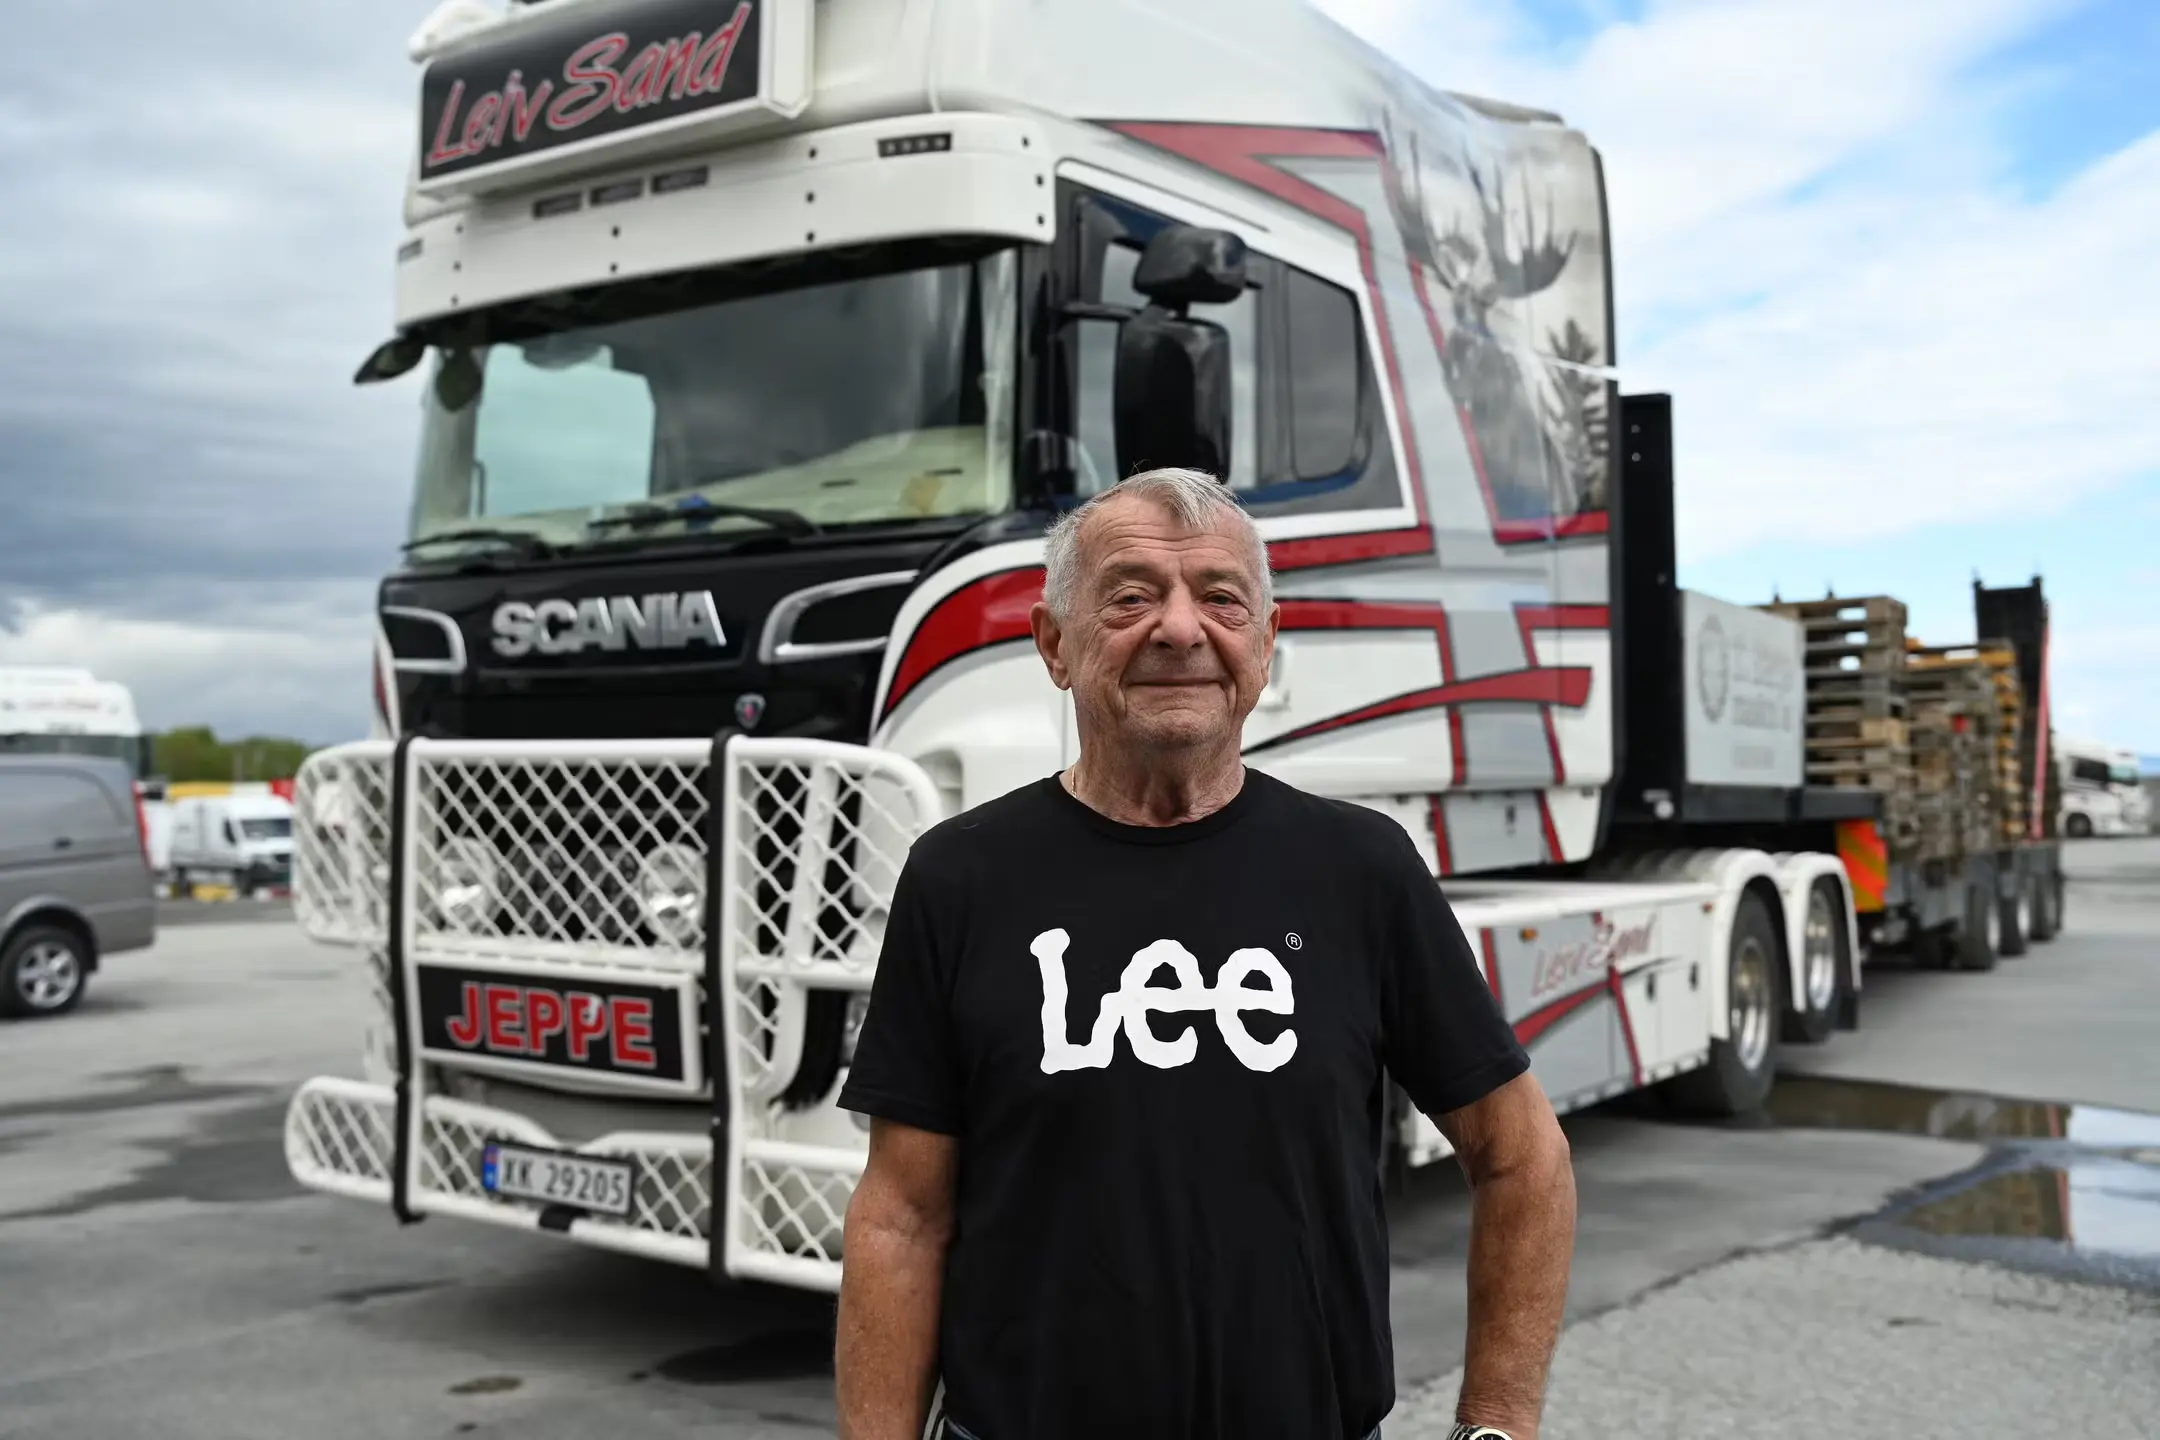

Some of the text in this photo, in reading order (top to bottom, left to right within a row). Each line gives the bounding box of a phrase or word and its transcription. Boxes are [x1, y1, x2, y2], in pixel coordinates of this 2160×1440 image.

[425, 2, 752, 167] Leiv Sand
[491, 590, 727, 657] SCANIA
[446, 981, 657, 1068] JEPPE
[1030, 928, 1298, 1075] Lee
[544, 1161, 624, 1207] 29205
